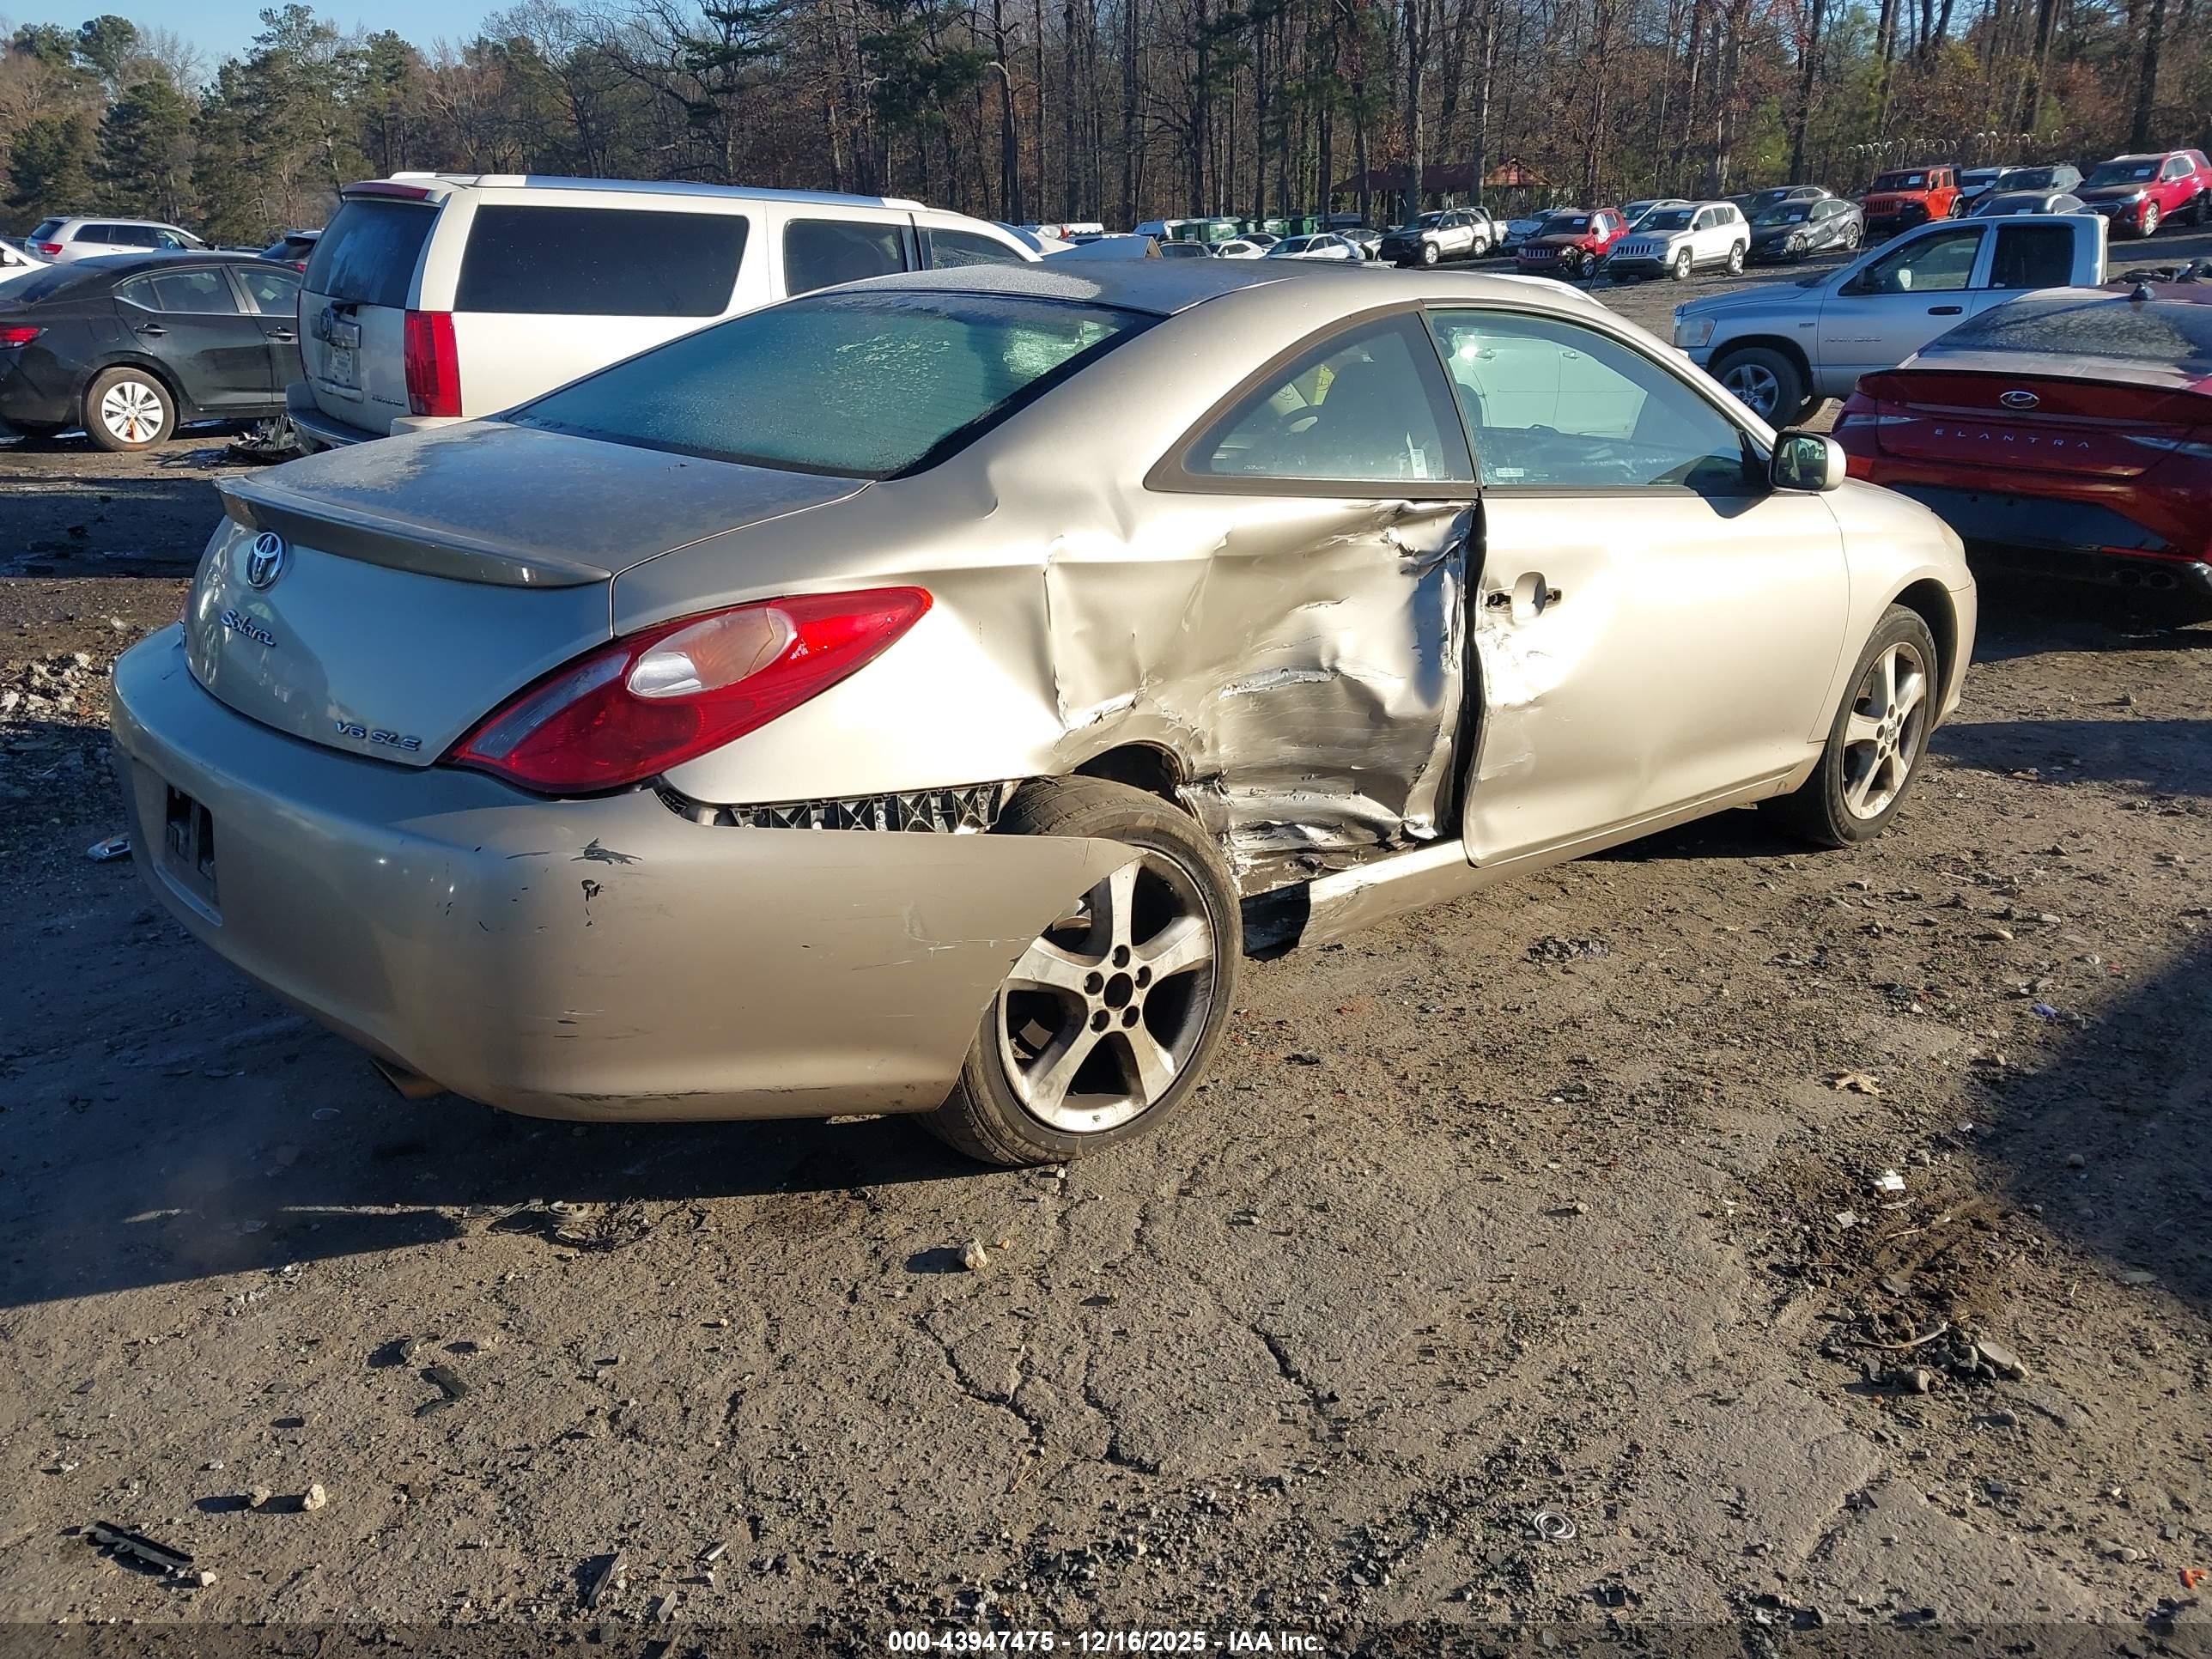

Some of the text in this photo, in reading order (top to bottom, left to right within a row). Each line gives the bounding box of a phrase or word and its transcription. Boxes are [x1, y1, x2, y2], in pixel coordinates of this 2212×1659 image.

[1934, 428, 2089, 448] ELANTRA
[220, 609, 276, 646] Solara
[336, 722, 420, 750] V6 SLE
